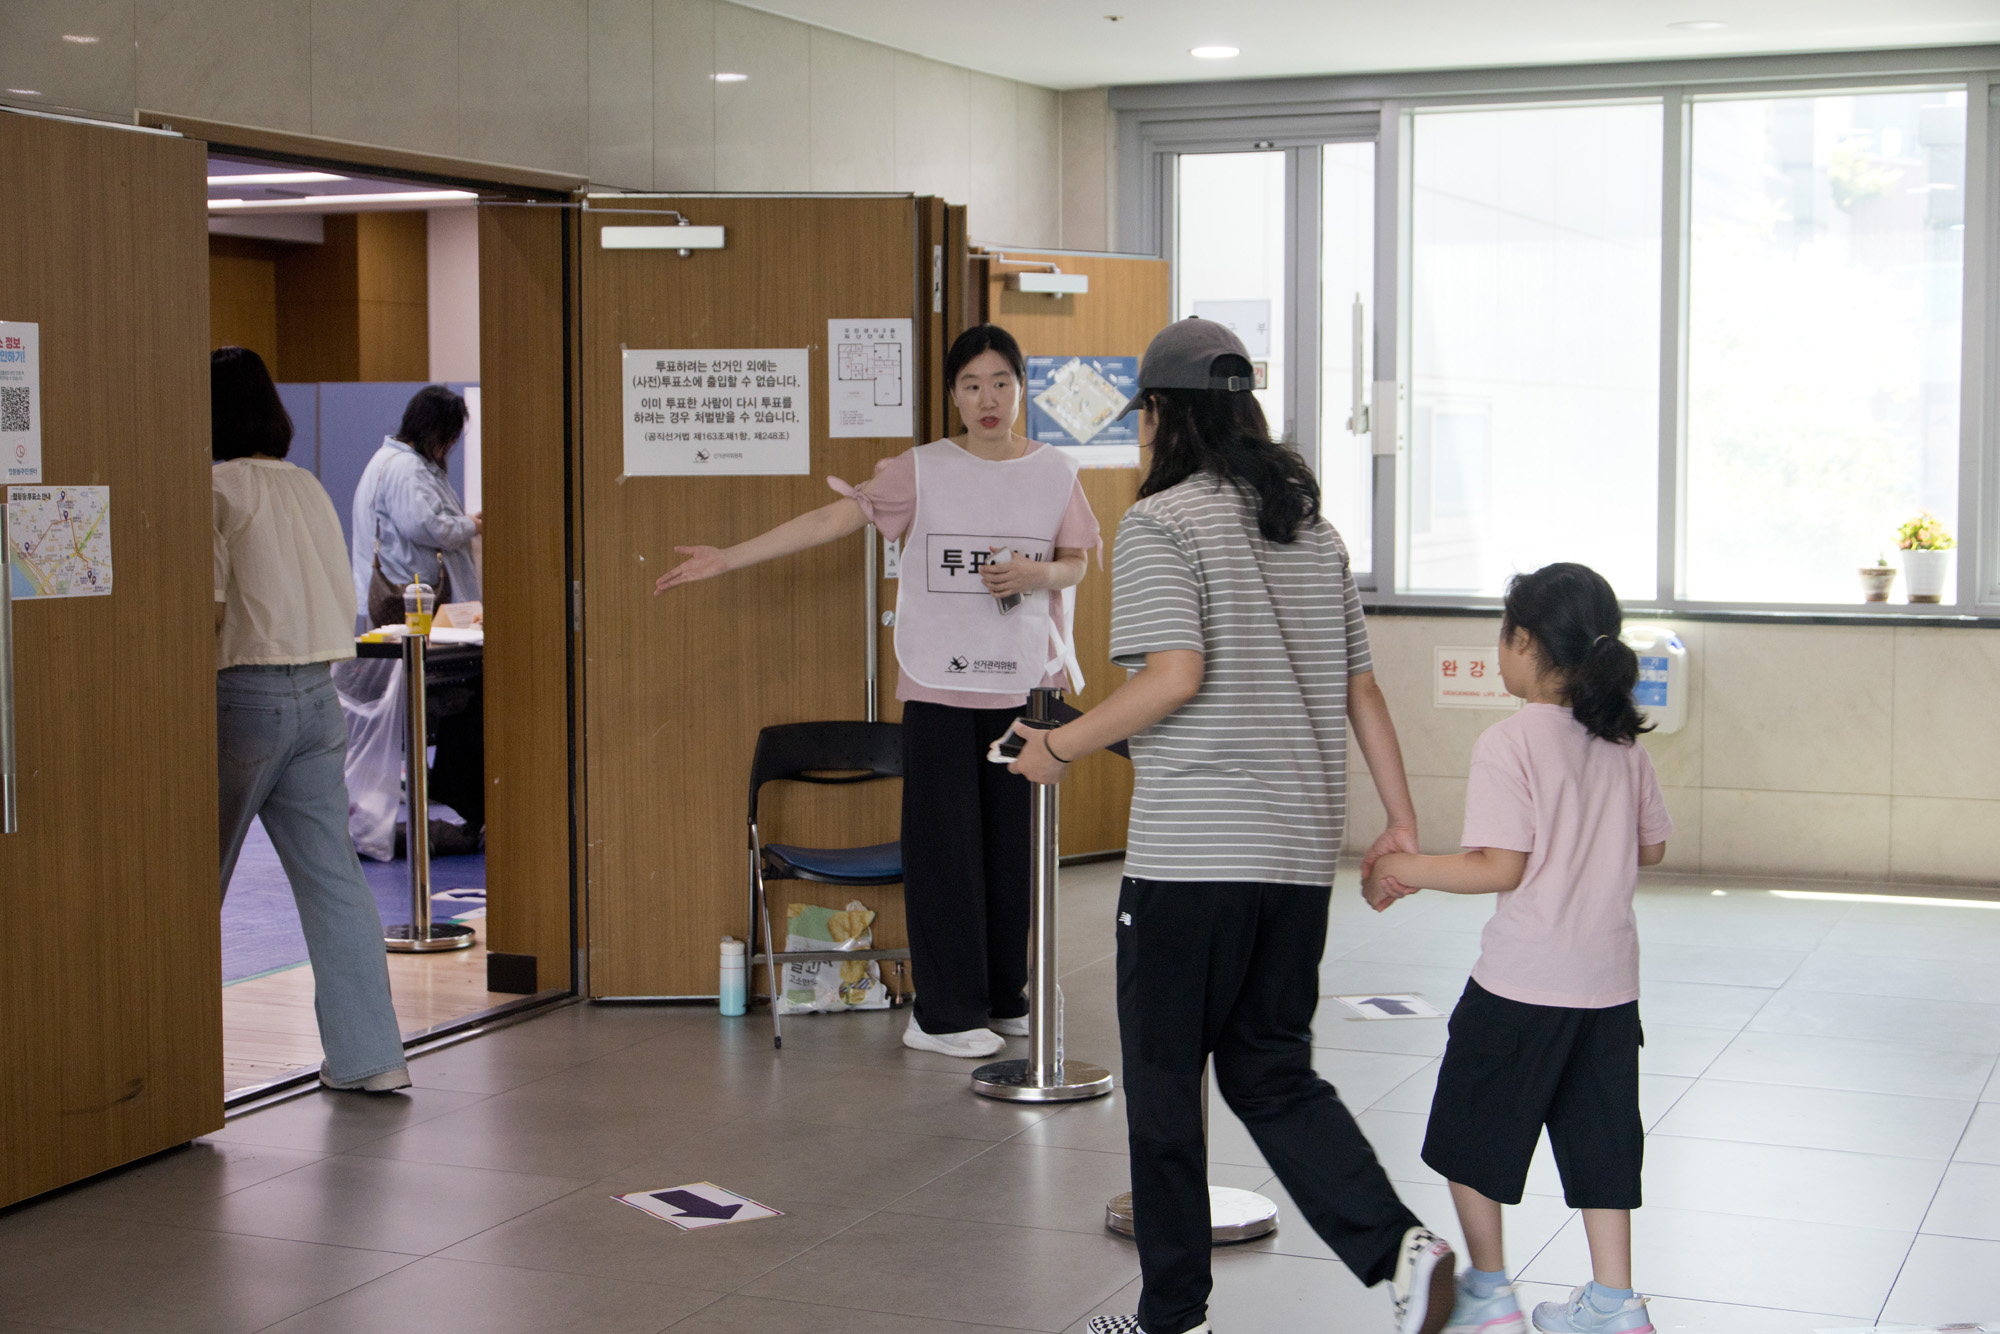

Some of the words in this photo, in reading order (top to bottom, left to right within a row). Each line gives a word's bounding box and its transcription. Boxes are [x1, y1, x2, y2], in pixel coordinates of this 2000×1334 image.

[655, 360, 708, 373] 투표하려는
[711, 360, 742, 373] 선거인
[746, 359, 778, 372] 외에는
[632, 375, 703, 389] (사전)투표소에
[706, 375, 738, 388] 출입할
[741, 375, 752, 388] 수
[755, 375, 801, 388] 없습니다.
[641, 397, 662, 410] 이미
[665, 397, 697, 410] 투표한
[701, 397, 732, 410] 사람이
[736, 397, 757, 409] 다시
[761, 396, 793, 409] 투표를
[633, 412, 665, 424] 하려는
[669, 412, 690, 424] 경우
[694, 411, 736, 424] 처벌받을
[739, 411, 751, 424] 수
[754, 411, 800, 423] 있습니다.
[644, 431, 690, 441] (공직선거법
[754, 431, 790, 441] 제248조)
[973, 660, 1018, 670] 선거관리위원회
[1441, 659, 1458, 677] 완
[1470, 660, 1485, 678] 강
